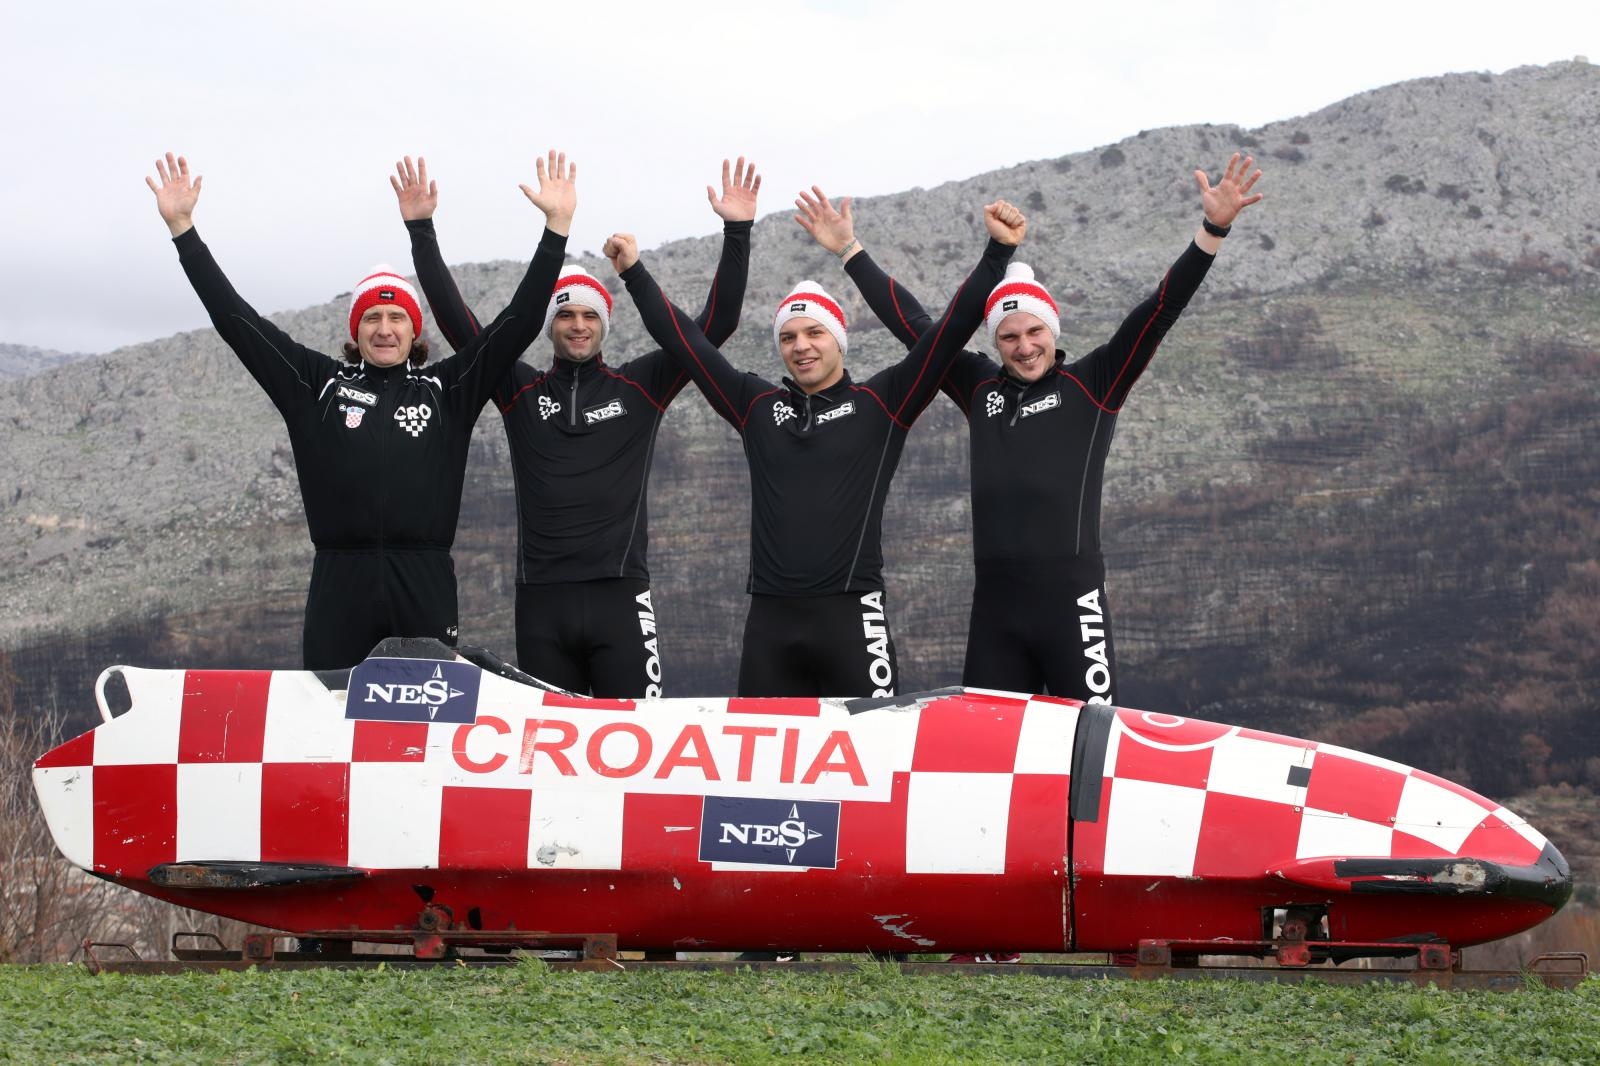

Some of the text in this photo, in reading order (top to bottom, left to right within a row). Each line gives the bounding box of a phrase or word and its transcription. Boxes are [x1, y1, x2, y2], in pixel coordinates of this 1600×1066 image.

[338, 386, 378, 406] NES
[1021, 394, 1059, 417] NES
[393, 403, 432, 421] CRO
[585, 402, 623, 422] NES
[817, 402, 854, 424] NES
[635, 589, 662, 698] ROATIA
[364, 679, 449, 706] NES
[451, 714, 869, 787] CROATIA
[718, 820, 806, 847] NES
